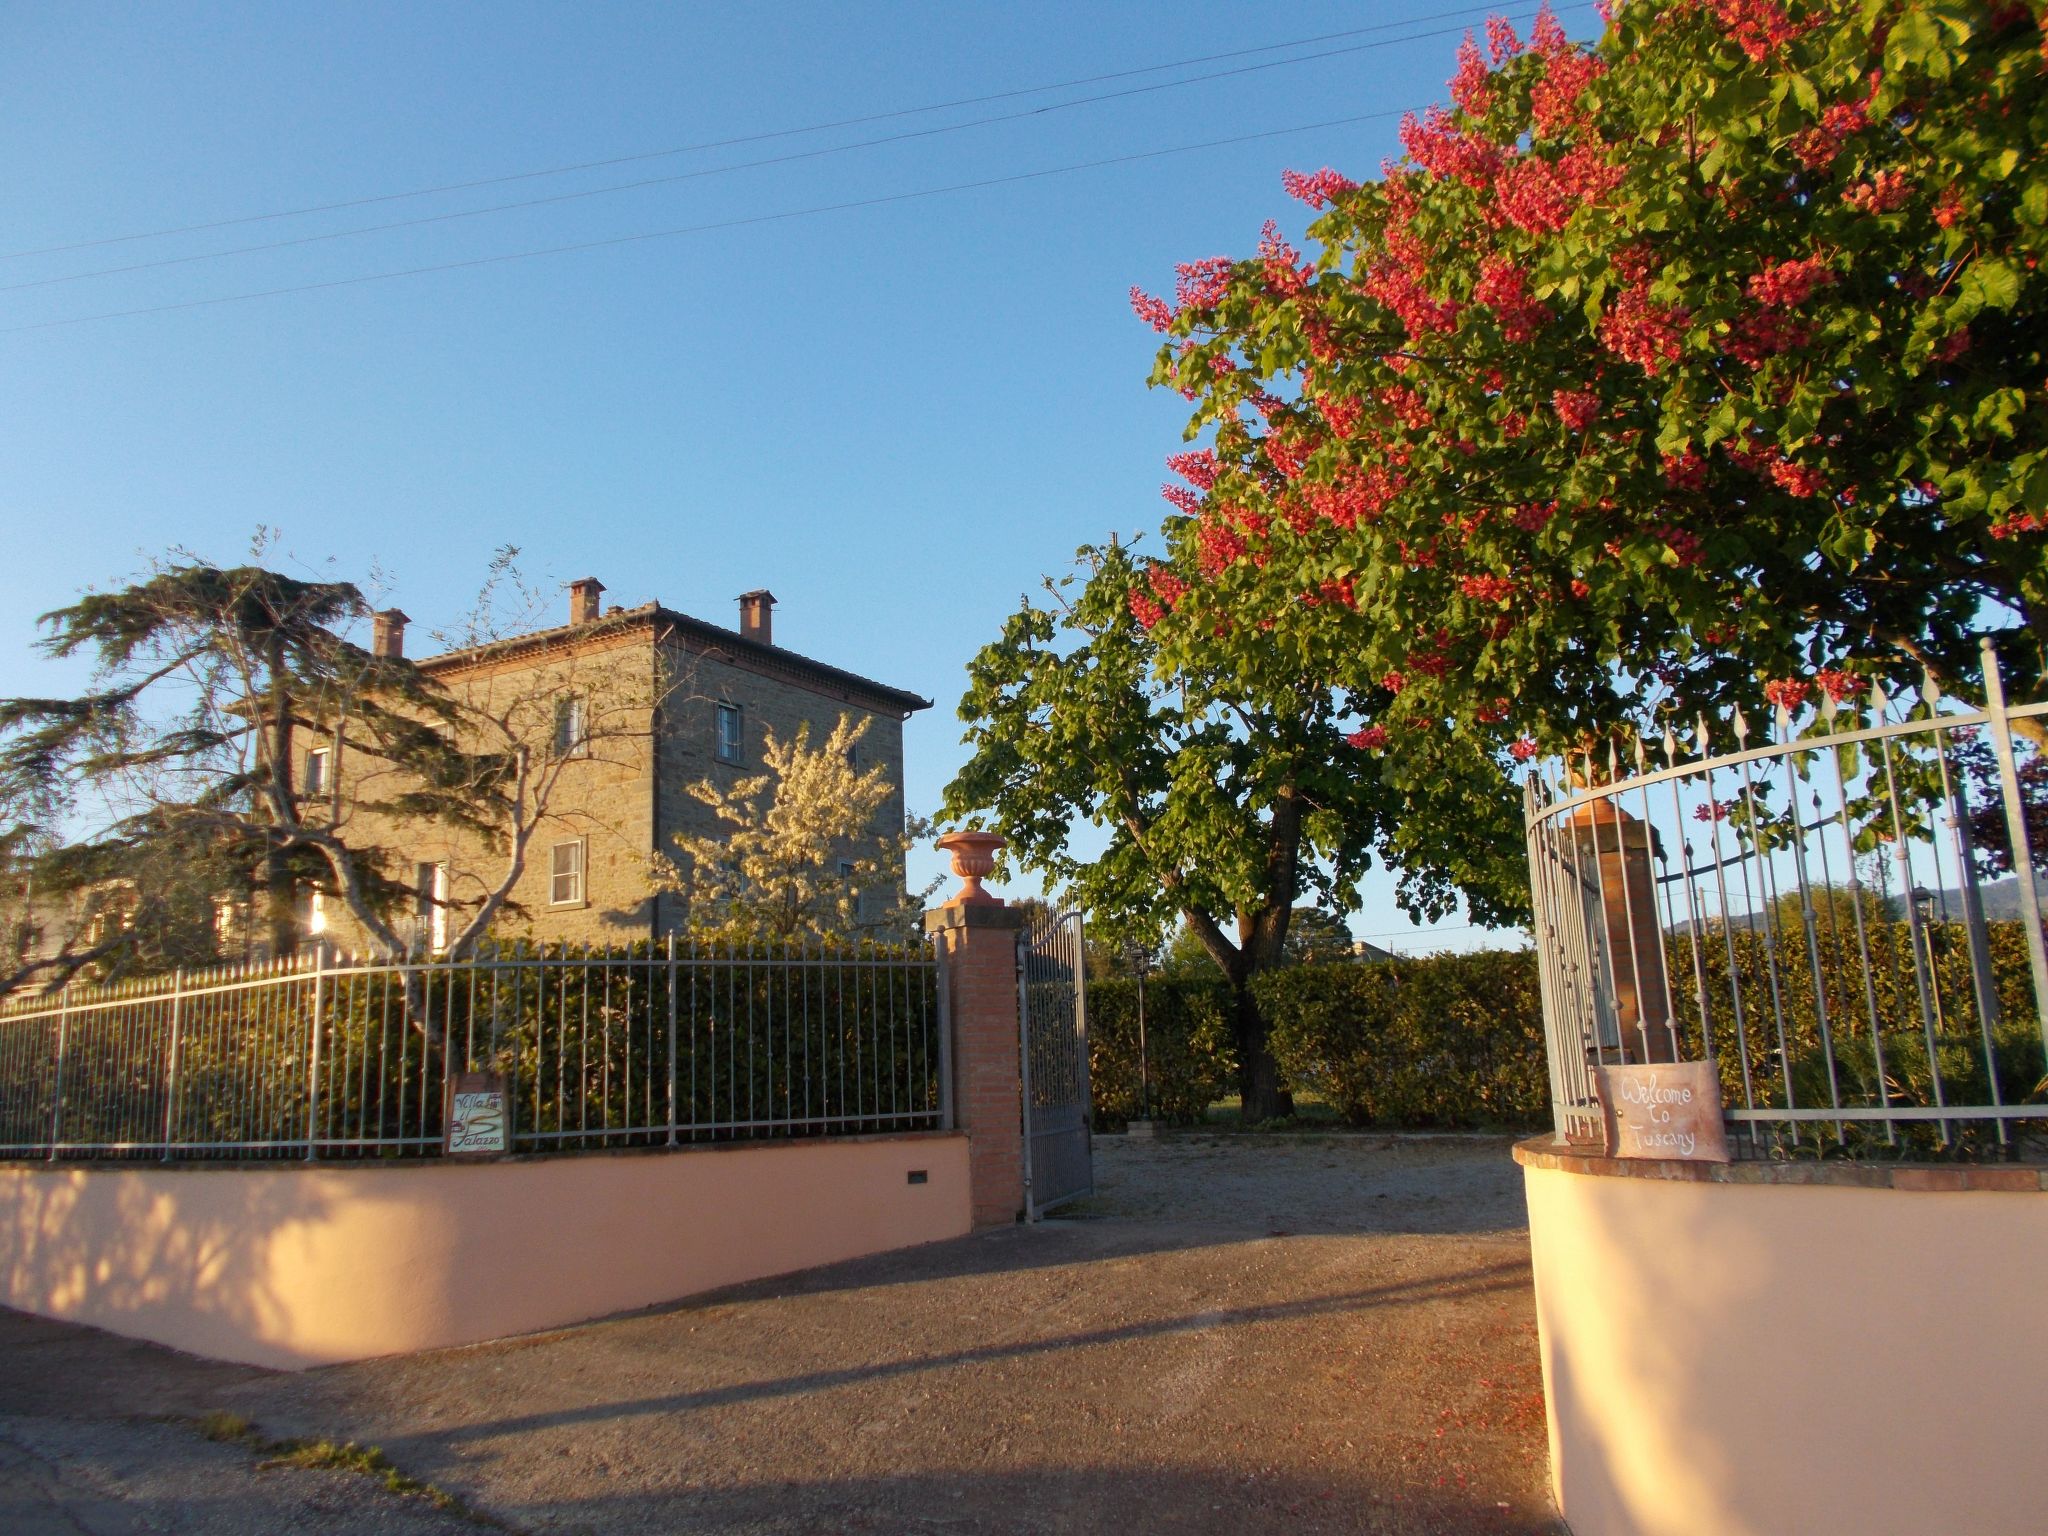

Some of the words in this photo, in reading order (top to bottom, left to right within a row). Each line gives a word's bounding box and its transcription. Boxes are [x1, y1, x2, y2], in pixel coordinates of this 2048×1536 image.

[456, 1094, 483, 1109] Villa
[1621, 1073, 1692, 1105] Welcome
[1646, 1103, 1670, 1123] to
[1629, 1125, 1695, 1156] Tuscany
